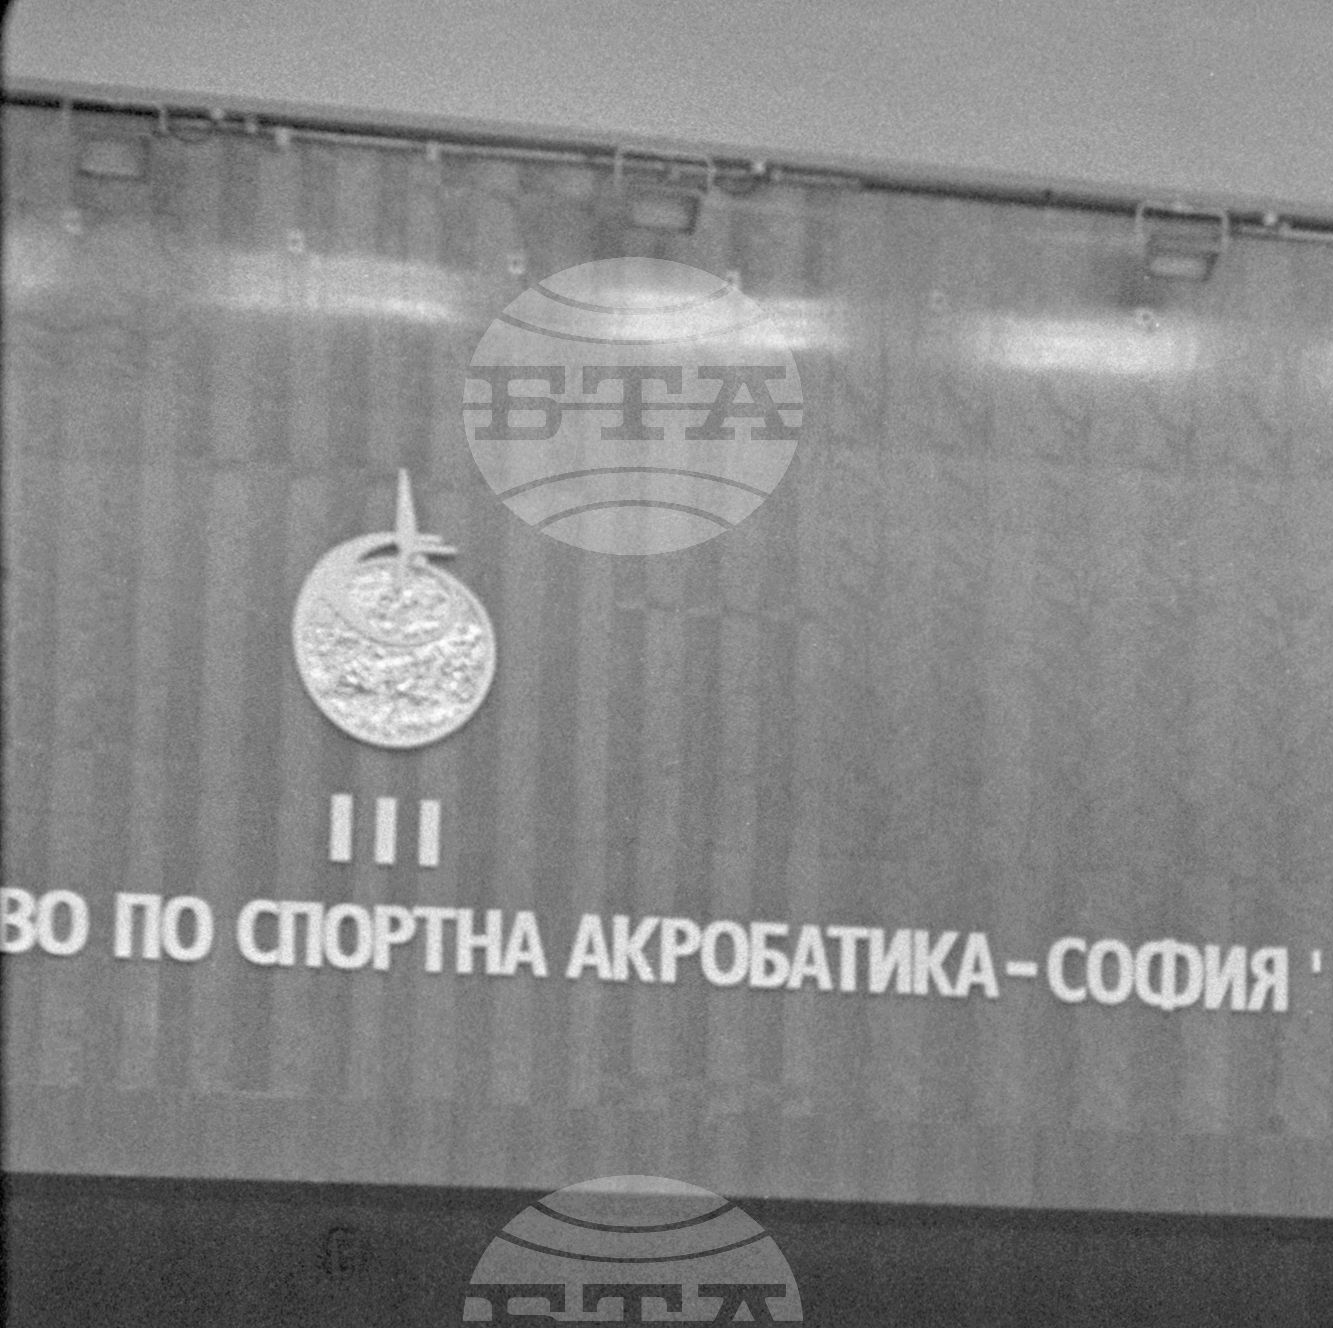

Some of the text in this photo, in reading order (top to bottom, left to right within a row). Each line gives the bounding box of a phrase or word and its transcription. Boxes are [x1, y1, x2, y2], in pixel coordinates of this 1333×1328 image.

[329, 792, 442, 867] III
[0, 887, 90, 956] ВО
[113, 892, 215, 962] ПО
[236, 898, 549, 978] СПОРТНА
